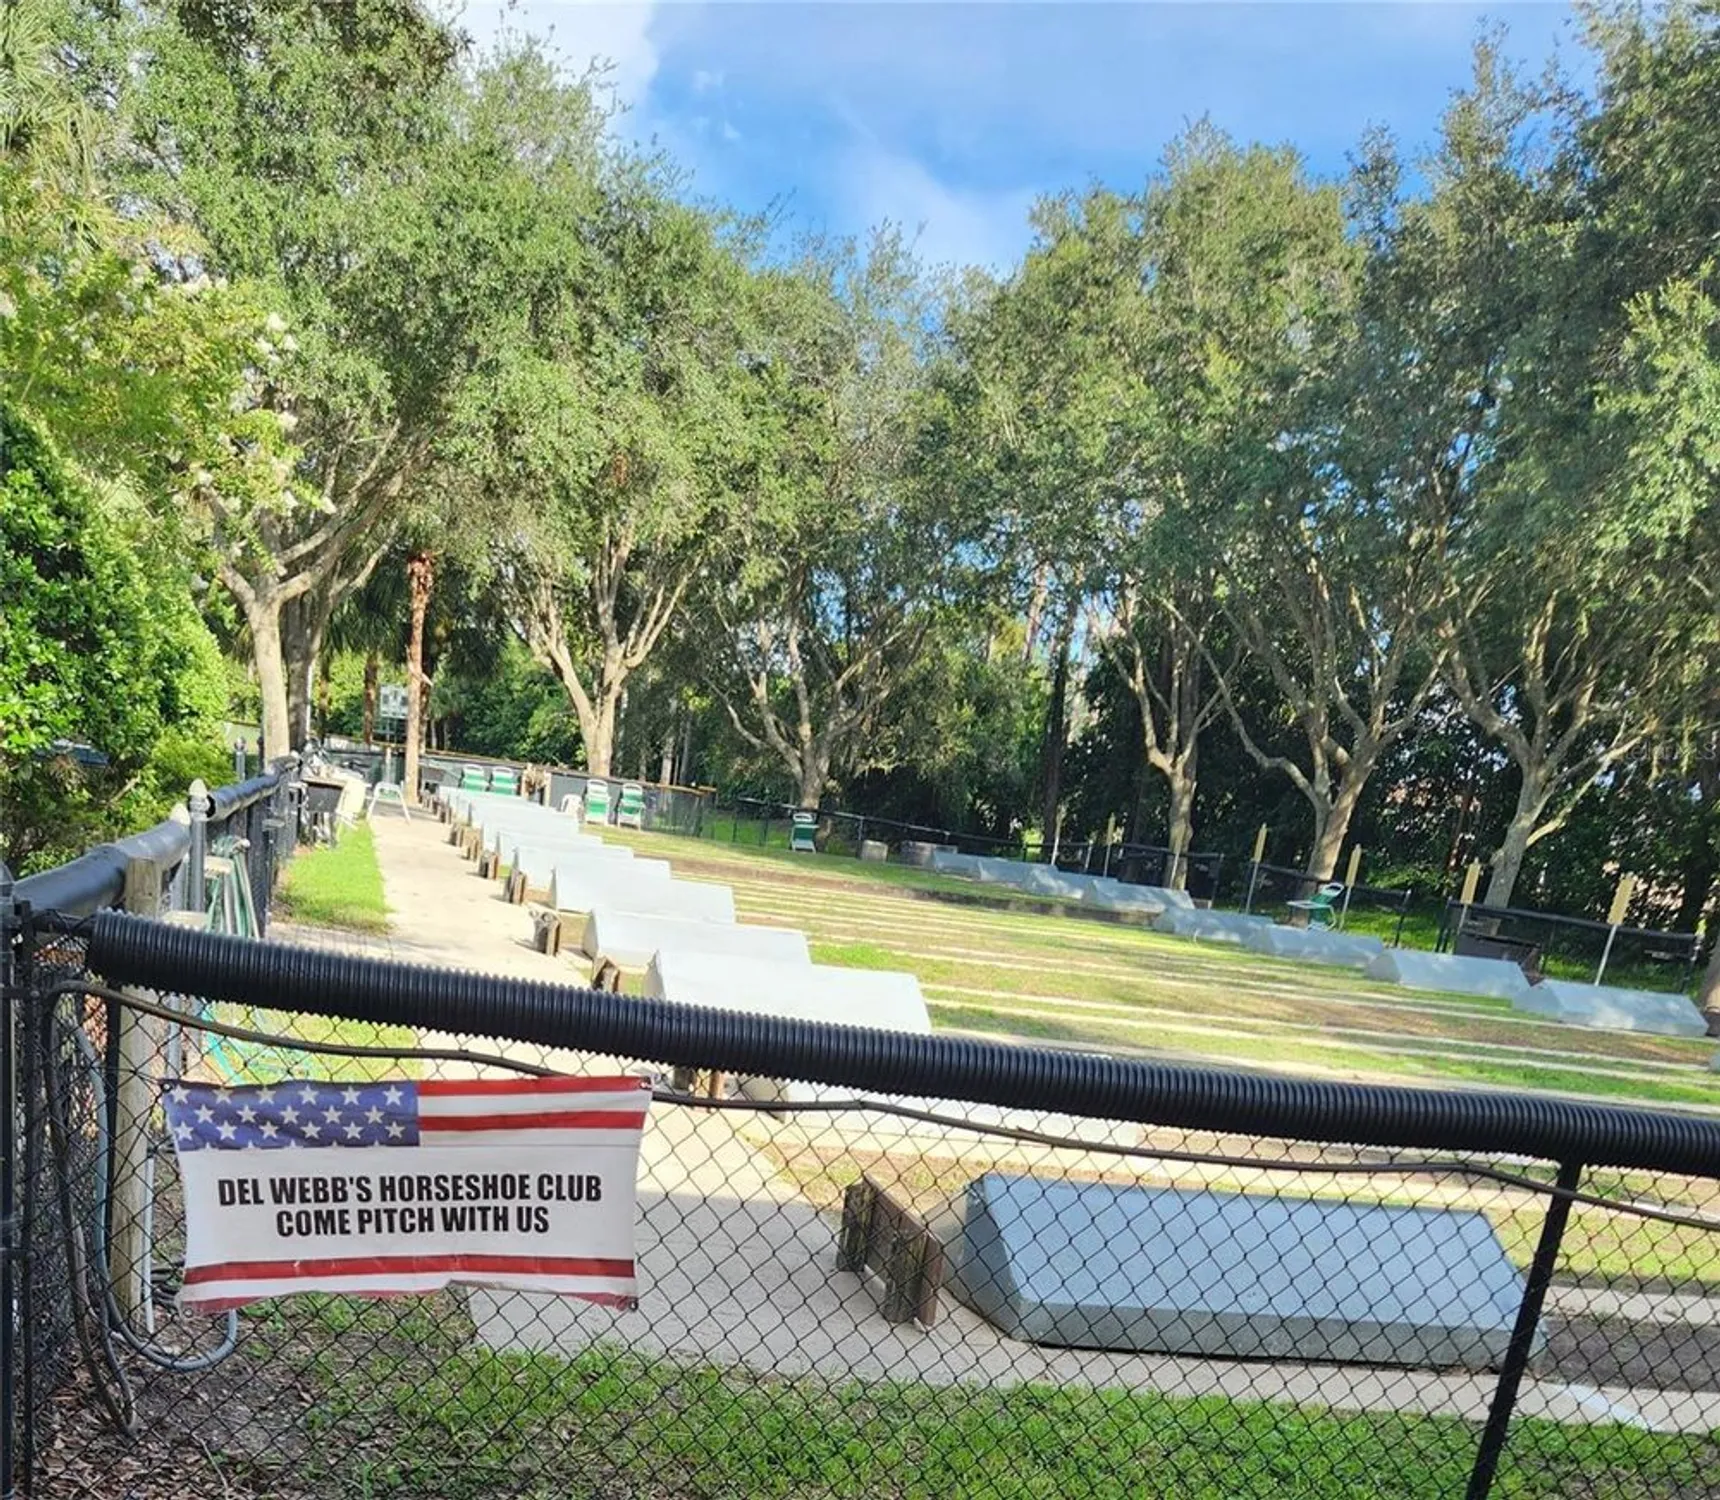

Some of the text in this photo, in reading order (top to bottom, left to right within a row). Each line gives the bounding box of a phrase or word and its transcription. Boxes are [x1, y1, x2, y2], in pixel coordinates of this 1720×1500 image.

[217, 1174, 602, 1207] DEL WEBB'S HORSESHOE CLUB
[276, 1205, 550, 1238] COME PITCH WITH US
